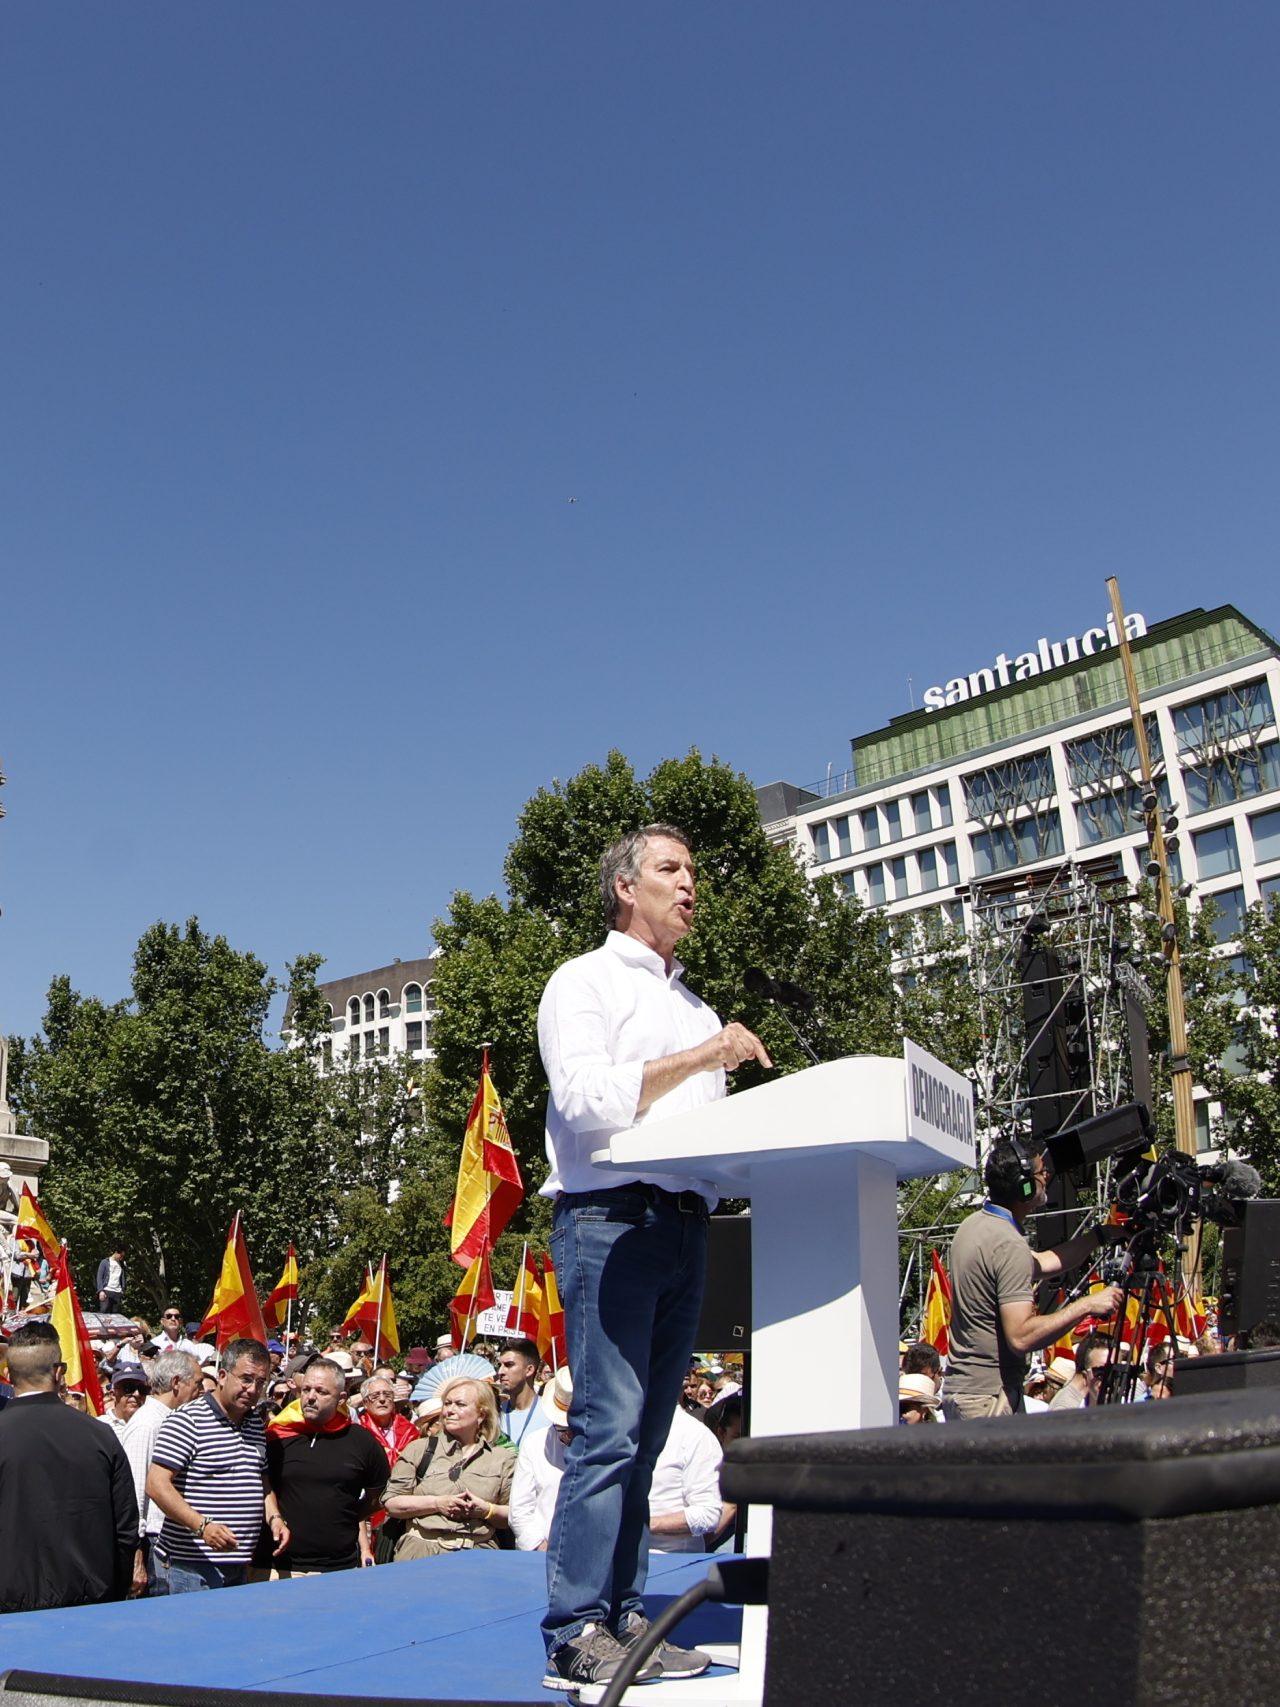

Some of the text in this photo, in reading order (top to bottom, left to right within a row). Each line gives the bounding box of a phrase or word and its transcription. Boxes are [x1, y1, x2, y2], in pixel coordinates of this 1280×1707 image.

[923, 612, 1148, 713] santalucía
[912, 1063, 973, 1147] DEMOCRACIA
[1188, 1186, 1194, 1196] 6
[505, 1293, 513, 1302] TR
[484, 1313, 507, 1323] TE VE
[484, 1323, 495, 1332] EN
